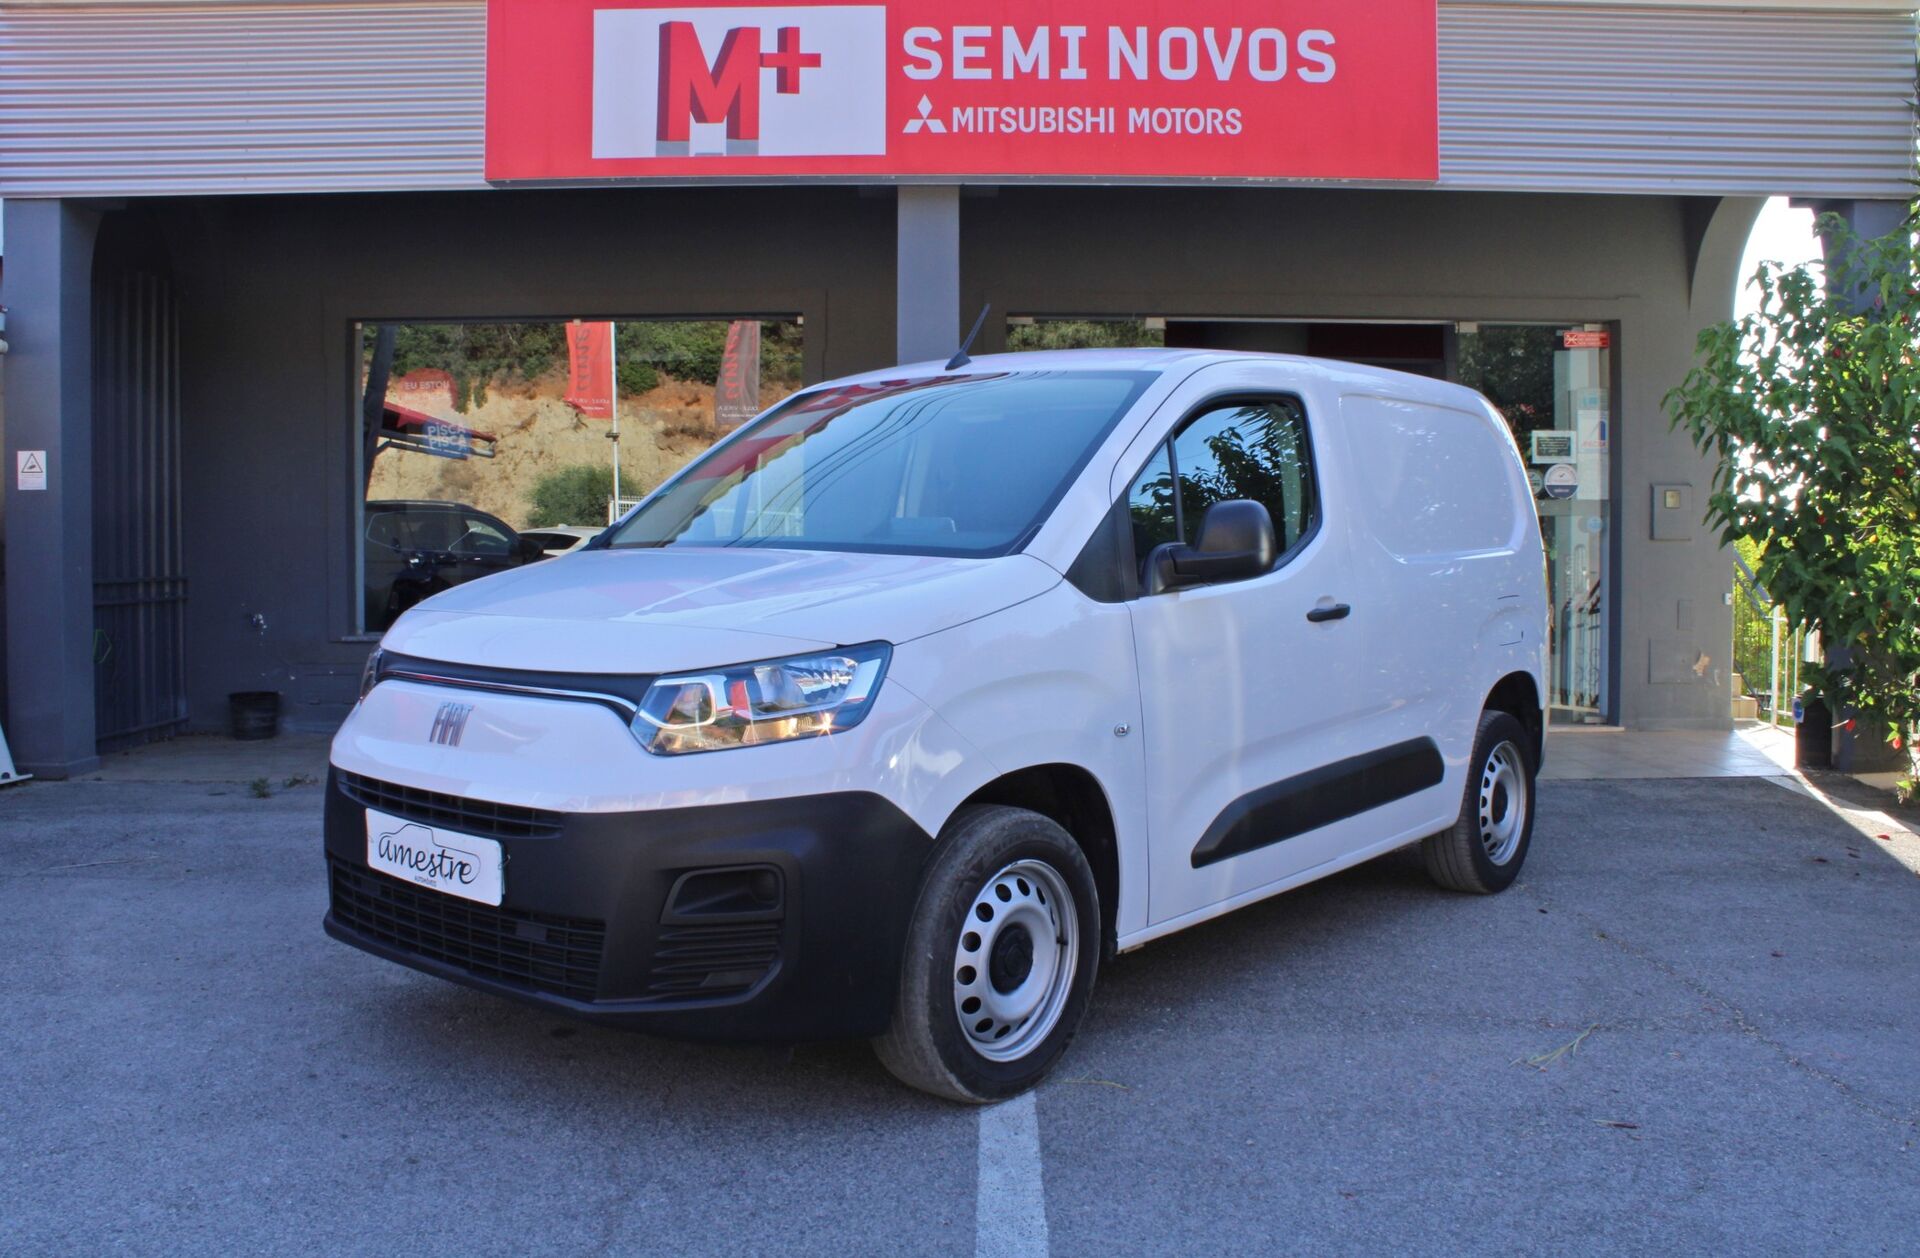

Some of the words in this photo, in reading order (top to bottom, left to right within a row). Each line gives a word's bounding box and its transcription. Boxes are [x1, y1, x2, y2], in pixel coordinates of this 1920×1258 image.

[902, 26, 1087, 81] SEMI
[1108, 26, 1336, 83] NOVOS
[952, 106, 1115, 134] MITSUBISHI
[1128, 107, 1242, 135] MOTORS
[405, 382, 416, 390] EU
[429, 433, 467, 448] PISCA
[378, 834, 473, 885] amestre
